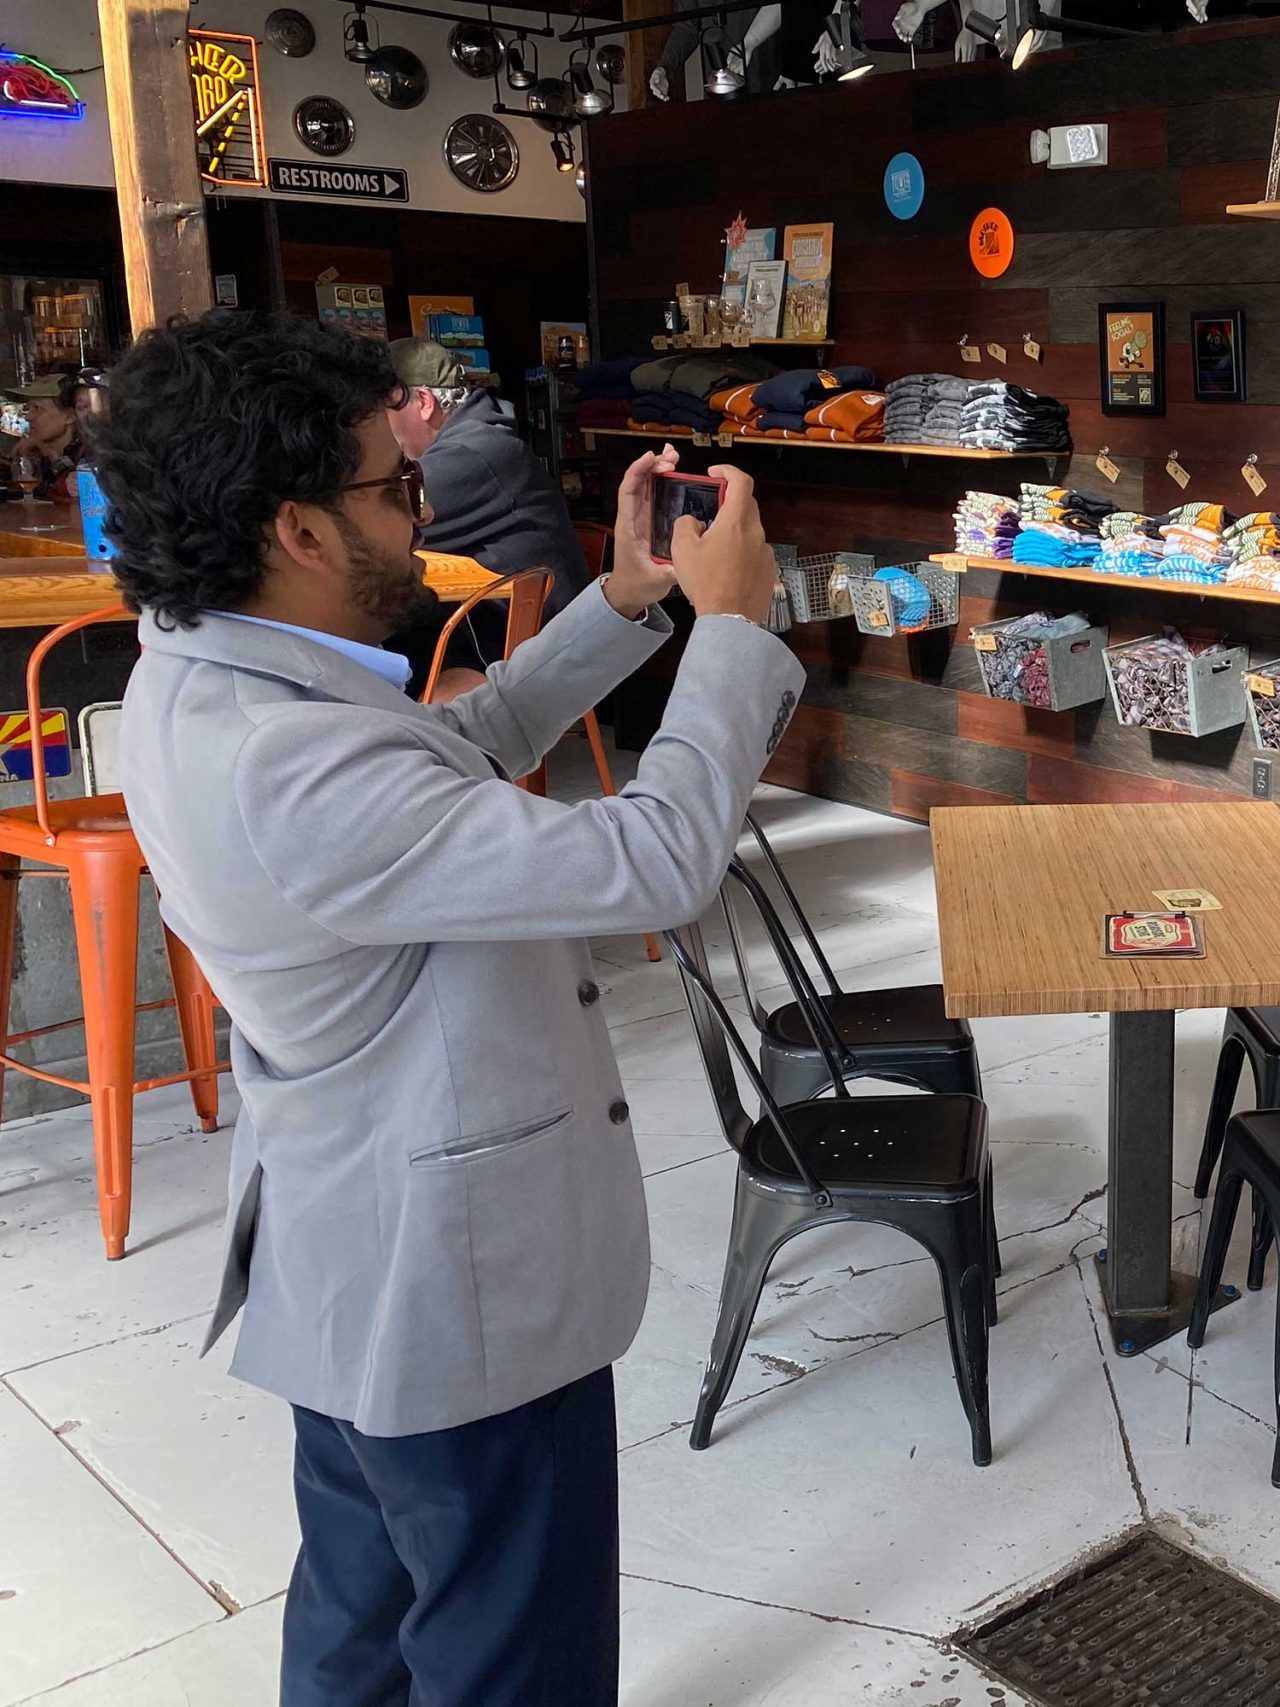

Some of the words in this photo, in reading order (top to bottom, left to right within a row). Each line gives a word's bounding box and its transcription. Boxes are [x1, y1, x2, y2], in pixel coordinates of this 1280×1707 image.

[189, 41, 246, 84] HER
[278, 167, 380, 192] RESTROOMS
[1109, 316, 1131, 334] FEELING
